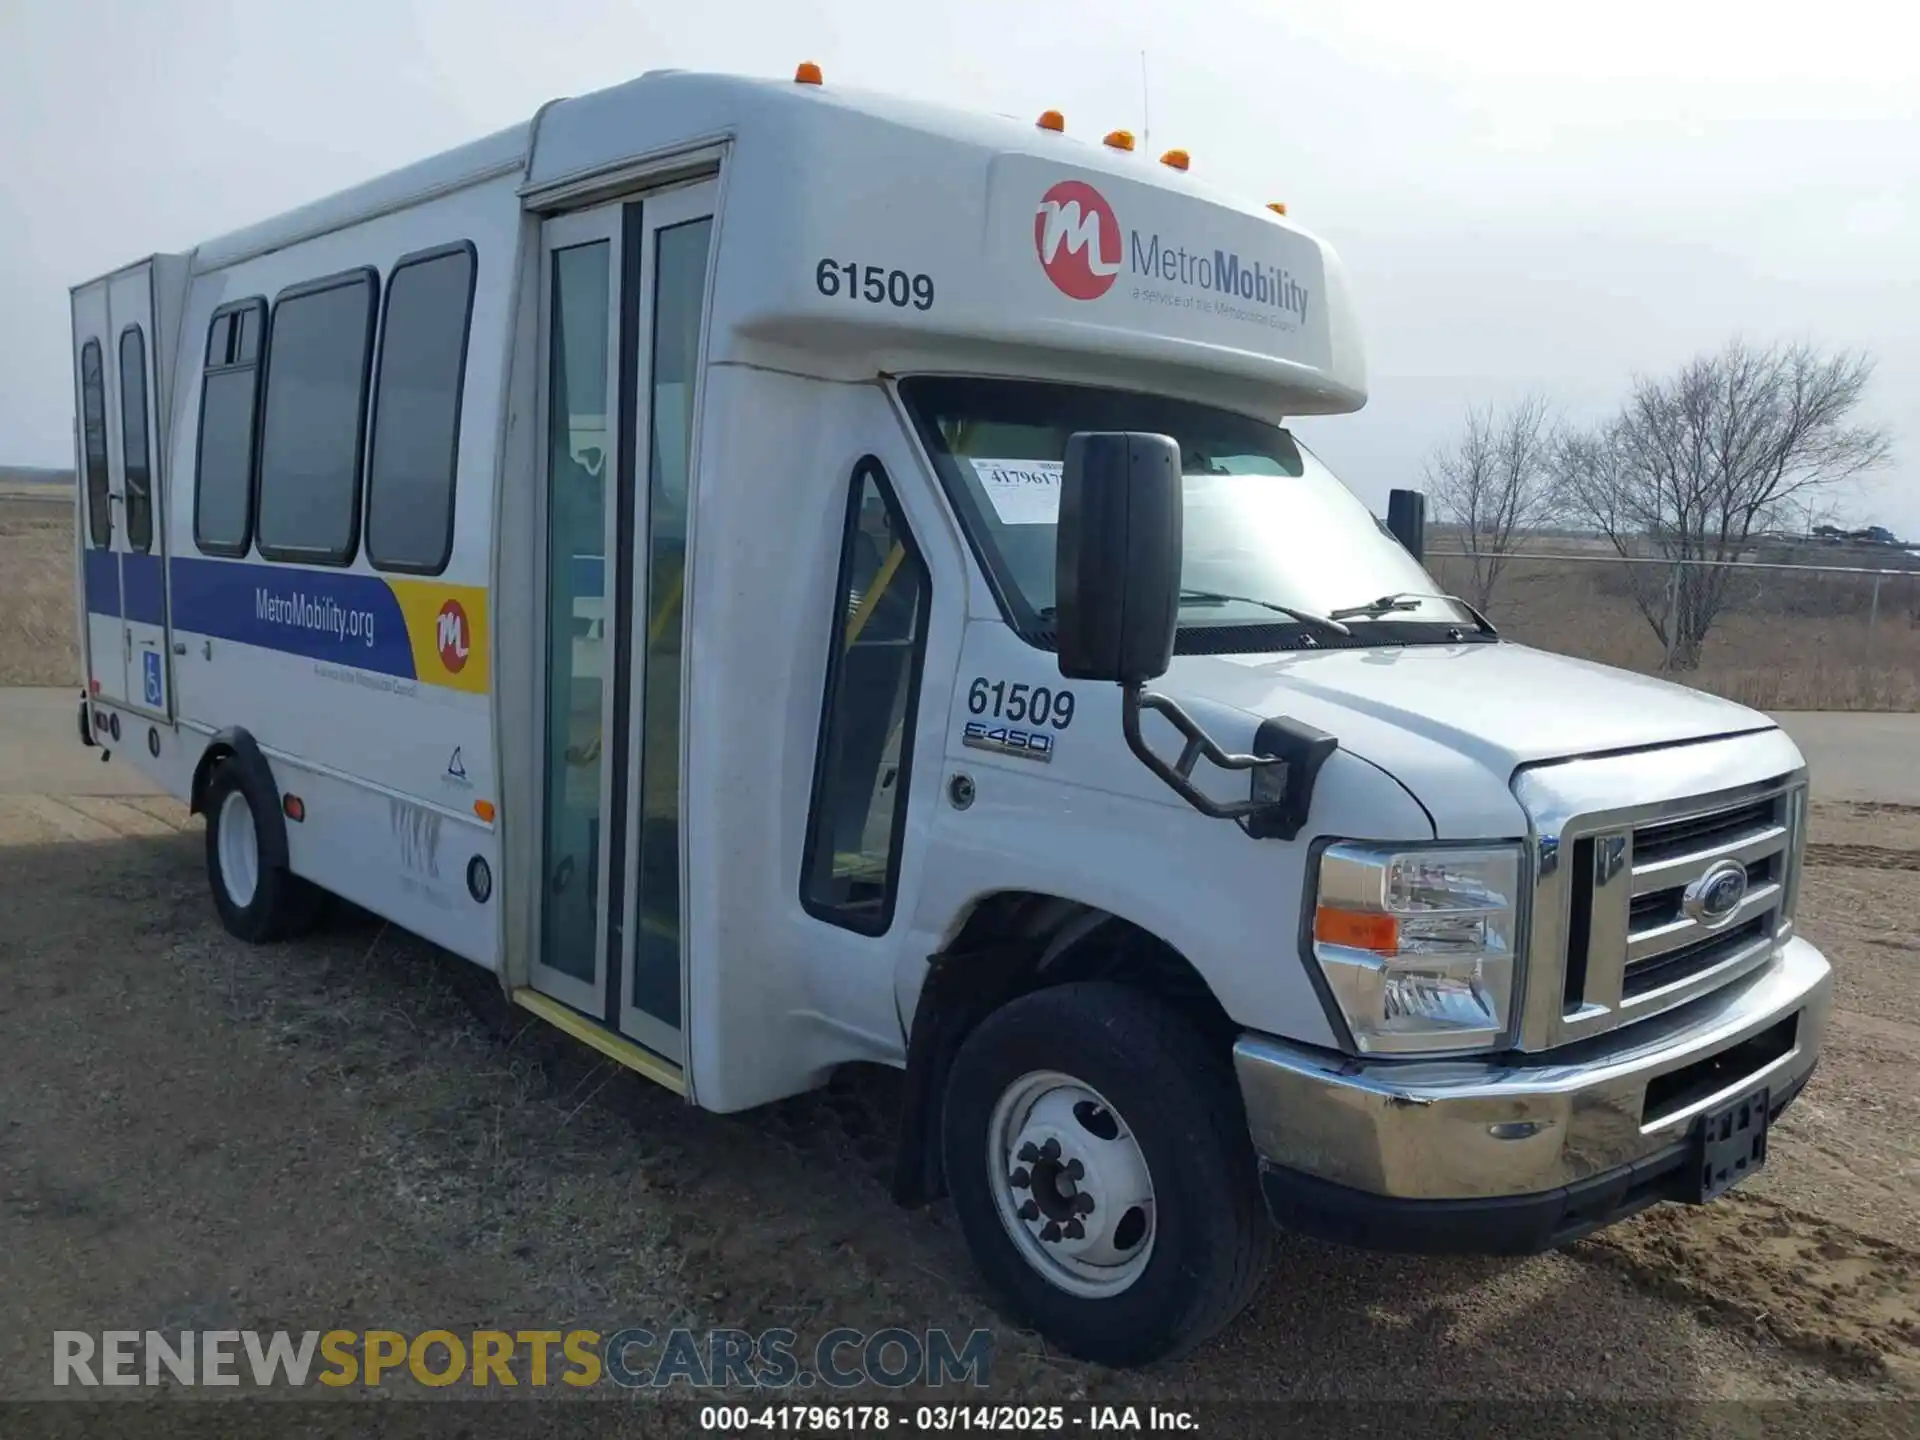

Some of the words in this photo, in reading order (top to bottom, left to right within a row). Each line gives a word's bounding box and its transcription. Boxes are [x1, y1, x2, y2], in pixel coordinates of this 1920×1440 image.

[816, 258, 934, 311] 61509
[1131, 229, 1308, 324] MetroMobility
[991, 469, 1064, 487] 4179617
[256, 587, 374, 648] MetroMobility.org
[968, 677, 1075, 730] 61509
[964, 721, 1050, 753] E-450
